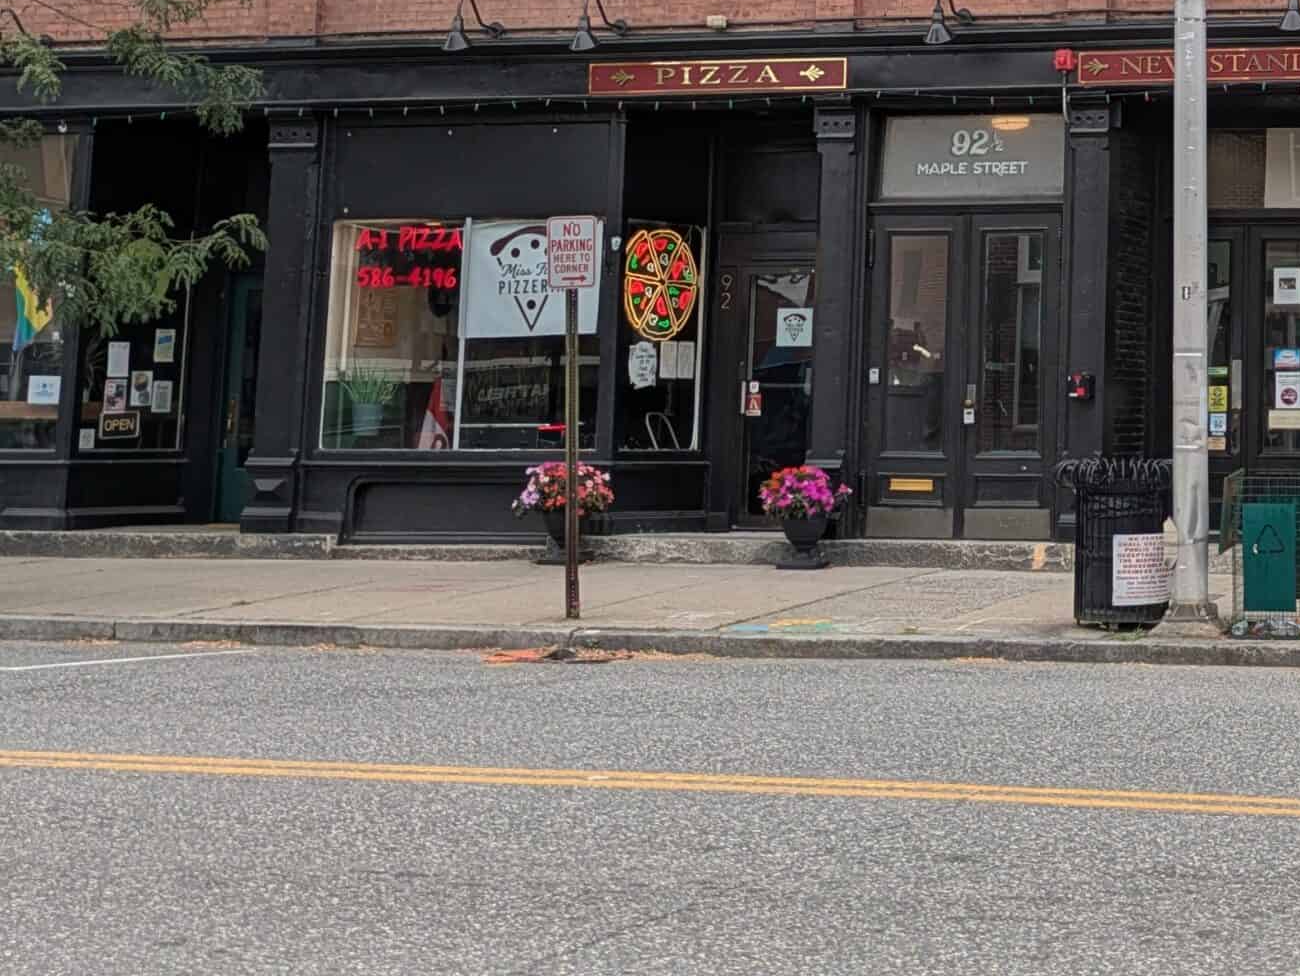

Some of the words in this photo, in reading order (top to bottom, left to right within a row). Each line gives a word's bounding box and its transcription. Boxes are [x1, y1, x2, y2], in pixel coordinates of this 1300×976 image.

[654, 64, 781, 85] PIZZA
[916, 162, 969, 175] MAPLE
[973, 160, 1029, 176] STREET
[563, 223, 582, 237] NO
[356, 226, 388, 251] A-1
[397, 225, 463, 252] PIZZA
[551, 239, 593, 253] PARKING
[553, 253, 577, 263] HERE
[580, 252, 591, 263] TO
[499, 262, 532, 278] Miss
[554, 263, 589, 274] CORNER
[356, 266, 457, 289] 586-4196
[104, 418, 134, 433] OPEN
